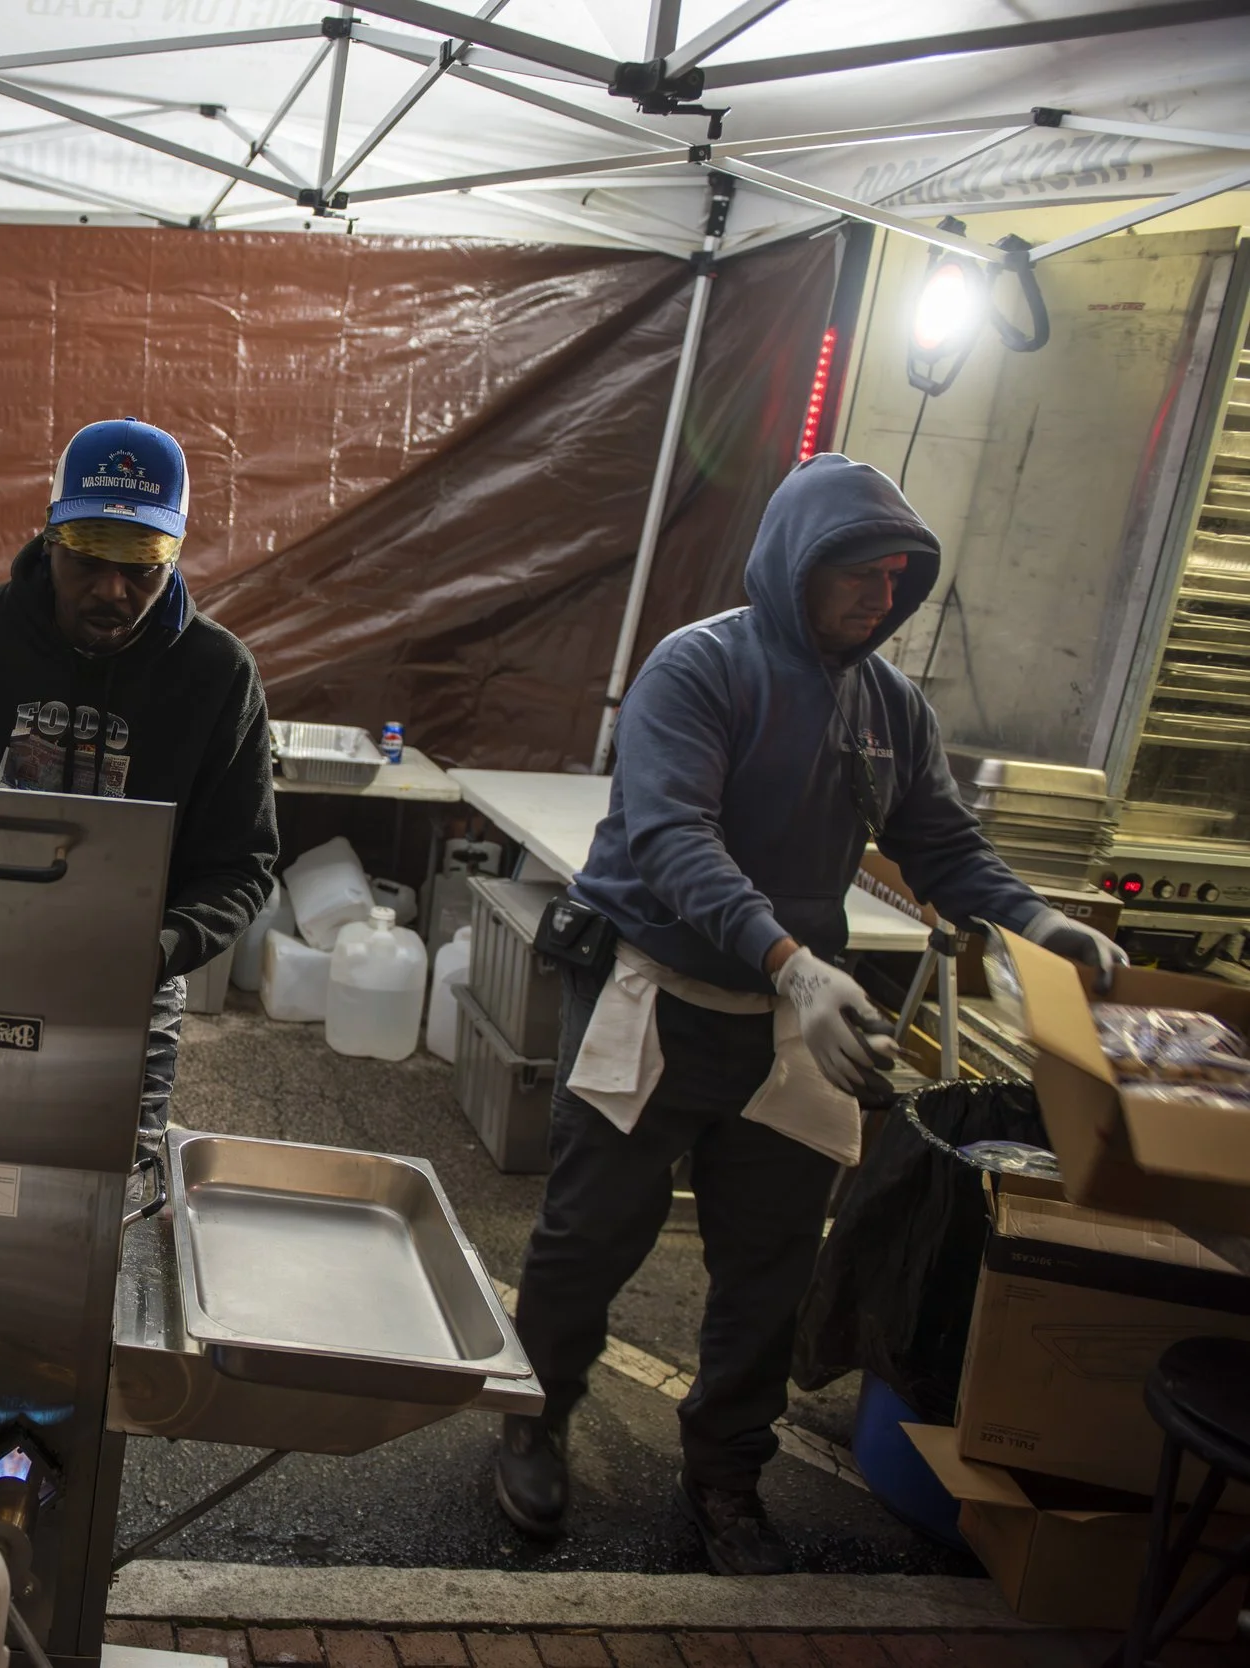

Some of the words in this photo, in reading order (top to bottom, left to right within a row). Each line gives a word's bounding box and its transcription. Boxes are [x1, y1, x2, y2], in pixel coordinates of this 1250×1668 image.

[82, 475, 138, 490] WASHINGTON
[139, 480, 161, 495] CRAB
[11, 700, 129, 751] FOOD
[1009, 1437, 1035, 1452] FULL
